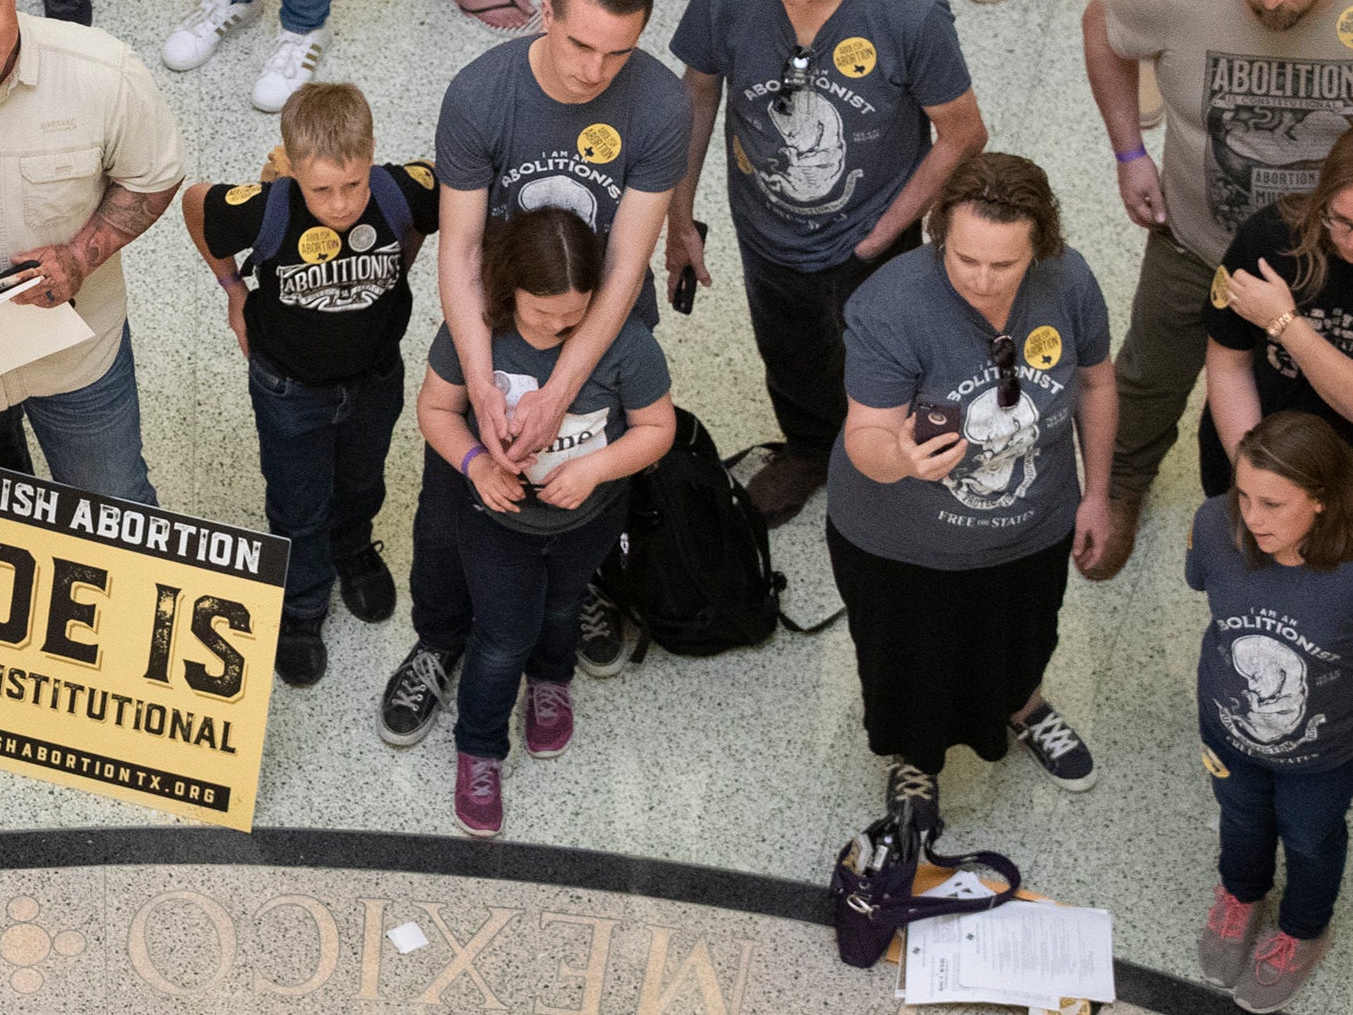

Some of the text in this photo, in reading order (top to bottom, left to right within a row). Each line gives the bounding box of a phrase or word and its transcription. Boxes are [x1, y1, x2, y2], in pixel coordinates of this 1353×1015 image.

[501, 158, 622, 204] ABOLITIONIS
[69, 498, 263, 575] ABORTION
[938, 510, 977, 527] FREE
[143, 582, 254, 700] IS
[127, 889, 763, 1015] MEXICO
